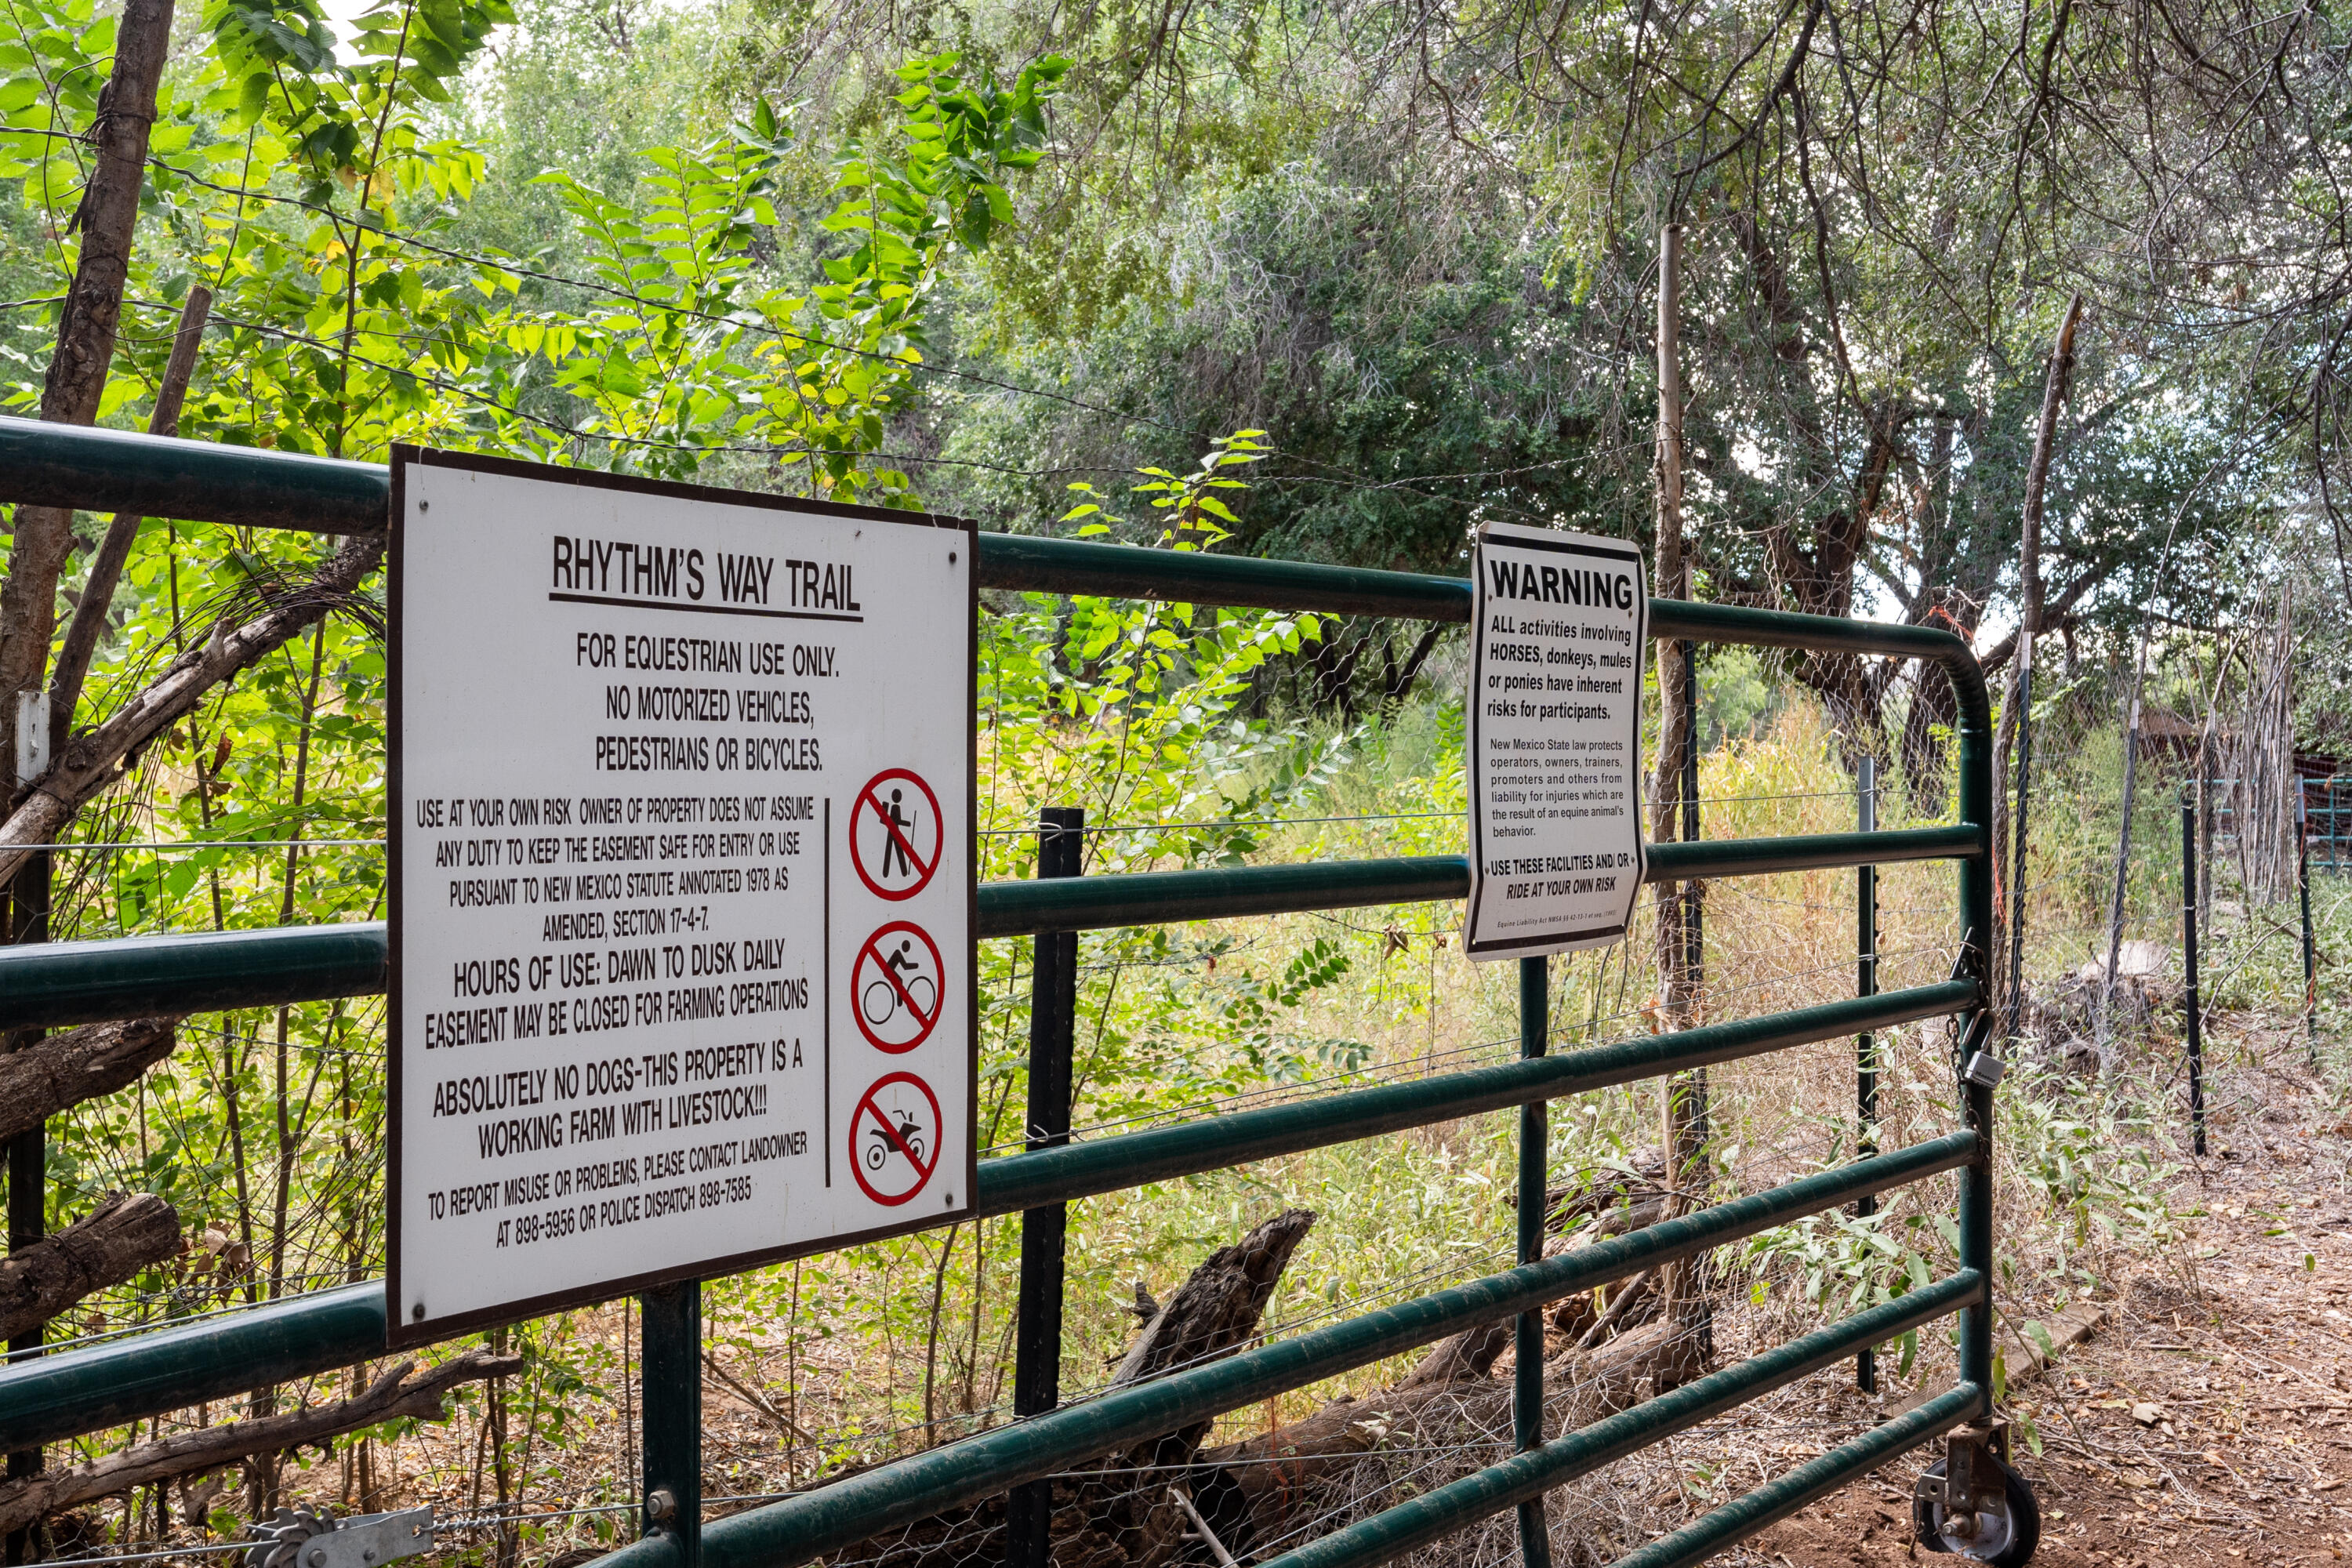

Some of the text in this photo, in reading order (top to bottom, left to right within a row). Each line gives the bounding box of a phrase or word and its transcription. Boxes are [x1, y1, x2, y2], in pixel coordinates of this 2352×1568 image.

[554, 535, 860, 612] RHYTHM'S WAY TRAIL
[1490, 560, 1632, 610] WARNING
[1491, 615, 1631, 647] ALL activities involving
[577, 633, 839, 677] FOR EQUESTRIAN USE ONLY.
[1490, 643, 1632, 670] HORSES, donkeys, mules
[1489, 673, 1622, 694] or ponies have inherent
[607, 685, 814, 729] NO MOTORIZED VEHICLES,
[1487, 699, 1610, 723] risks for participants.
[597, 735, 822, 771] PEDESTRIANS OR BICYCLES.
[1490, 739, 1623, 753] New Mexico State law protects
[1490, 757, 1622, 770] operators, owners, trainers,
[1491, 773, 1622, 788] promoters and others from
[1492, 791, 1526, 804] liability
[1530, 790, 1543, 801] for
[1546, 790, 1580, 804] injuries
[1582, 789, 1607, 800] which
[417, 796, 814, 828] USE AT YOUR OWN RISK OWNER OF PROPERTY DOES NOT ASSUME
[1492, 809, 1507, 820] the
[1509, 808, 1535, 819] result
[1537, 808, 1546, 818] of
[1561, 807, 1589, 820] equine
[1591, 805, 1624, 816] animal's
[436, 831, 800, 867] ANY DUTY TO KEEP THE EASEMENT SAFE FOR ENTRY OR USE
[1493, 826, 1536, 837] behavior.
[1491, 860, 1511, 876] USE
[1513, 858, 1544, 874] THESE
[1546, 855, 1593, 872] FACILITIES
[1617, 853, 1629, 867] OR
[450, 866, 788, 907] PURSUANT TO NEW MEXICO STATUTE ANNOTATED 1978 AS
[1507, 877, 1617, 899] RIDE AT YOUR OWN RISK
[543, 906, 709, 943] AMENDED, SECTION 17-4-7.
[455, 938, 785, 997] HOURS OF USE: DAWN TO DUSK DAILY
[426, 977, 808, 1050] EASEMENT MAY BE CLOSED FOR FARMING OPERATIONS
[433, 1038, 803, 1118] ABSOLUTELY NO DOGS-THIS PROPERTY IS A
[478, 1084, 767, 1159] WORKING FARM WITH LIVESTOCK!!!
[428, 1131, 807, 1220] TO REPORT MISUSE OR PROBLEMS, PLEASE CONTACT LANDOWNER
[496, 1175, 751, 1248] AT 898-5956 OR POLICE DISPATCH 898-7585
